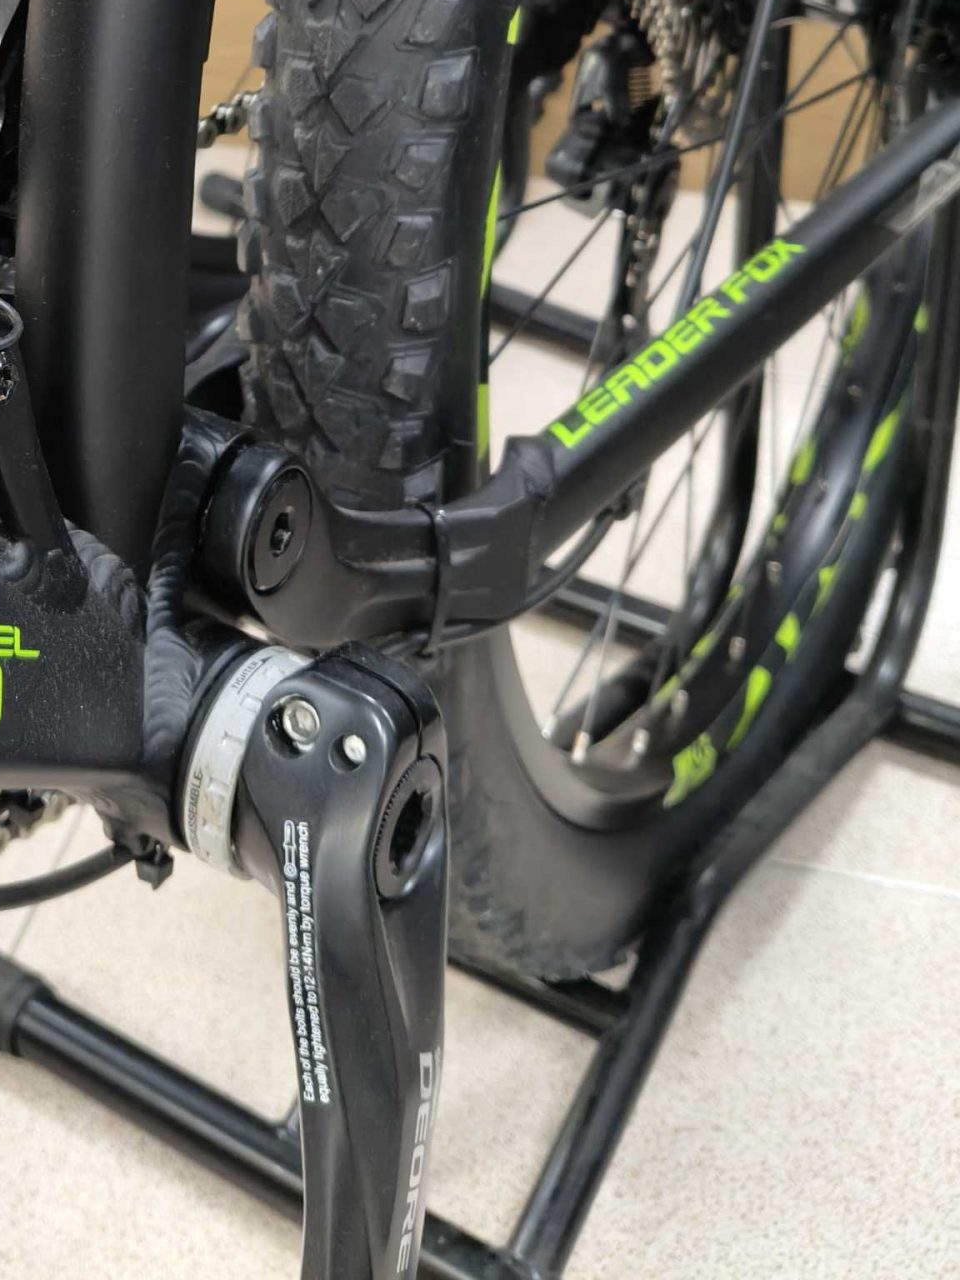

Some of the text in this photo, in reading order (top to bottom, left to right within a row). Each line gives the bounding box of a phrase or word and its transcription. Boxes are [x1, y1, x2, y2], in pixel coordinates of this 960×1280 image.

[548, 238, 806, 448] LEADER FOX
[296, 821, 310, 869] wrench
[299, 870, 313, 912] torque
[300, 913, 315, 931] by
[284, 880, 315, 1101] Each of the bolts should be evenly and
[306, 991, 318, 1004] to
[307, 1004, 327, 1060] tightened
[314, 1060, 331, 1104] equally
[396, 1051, 433, 1273] DEORE
